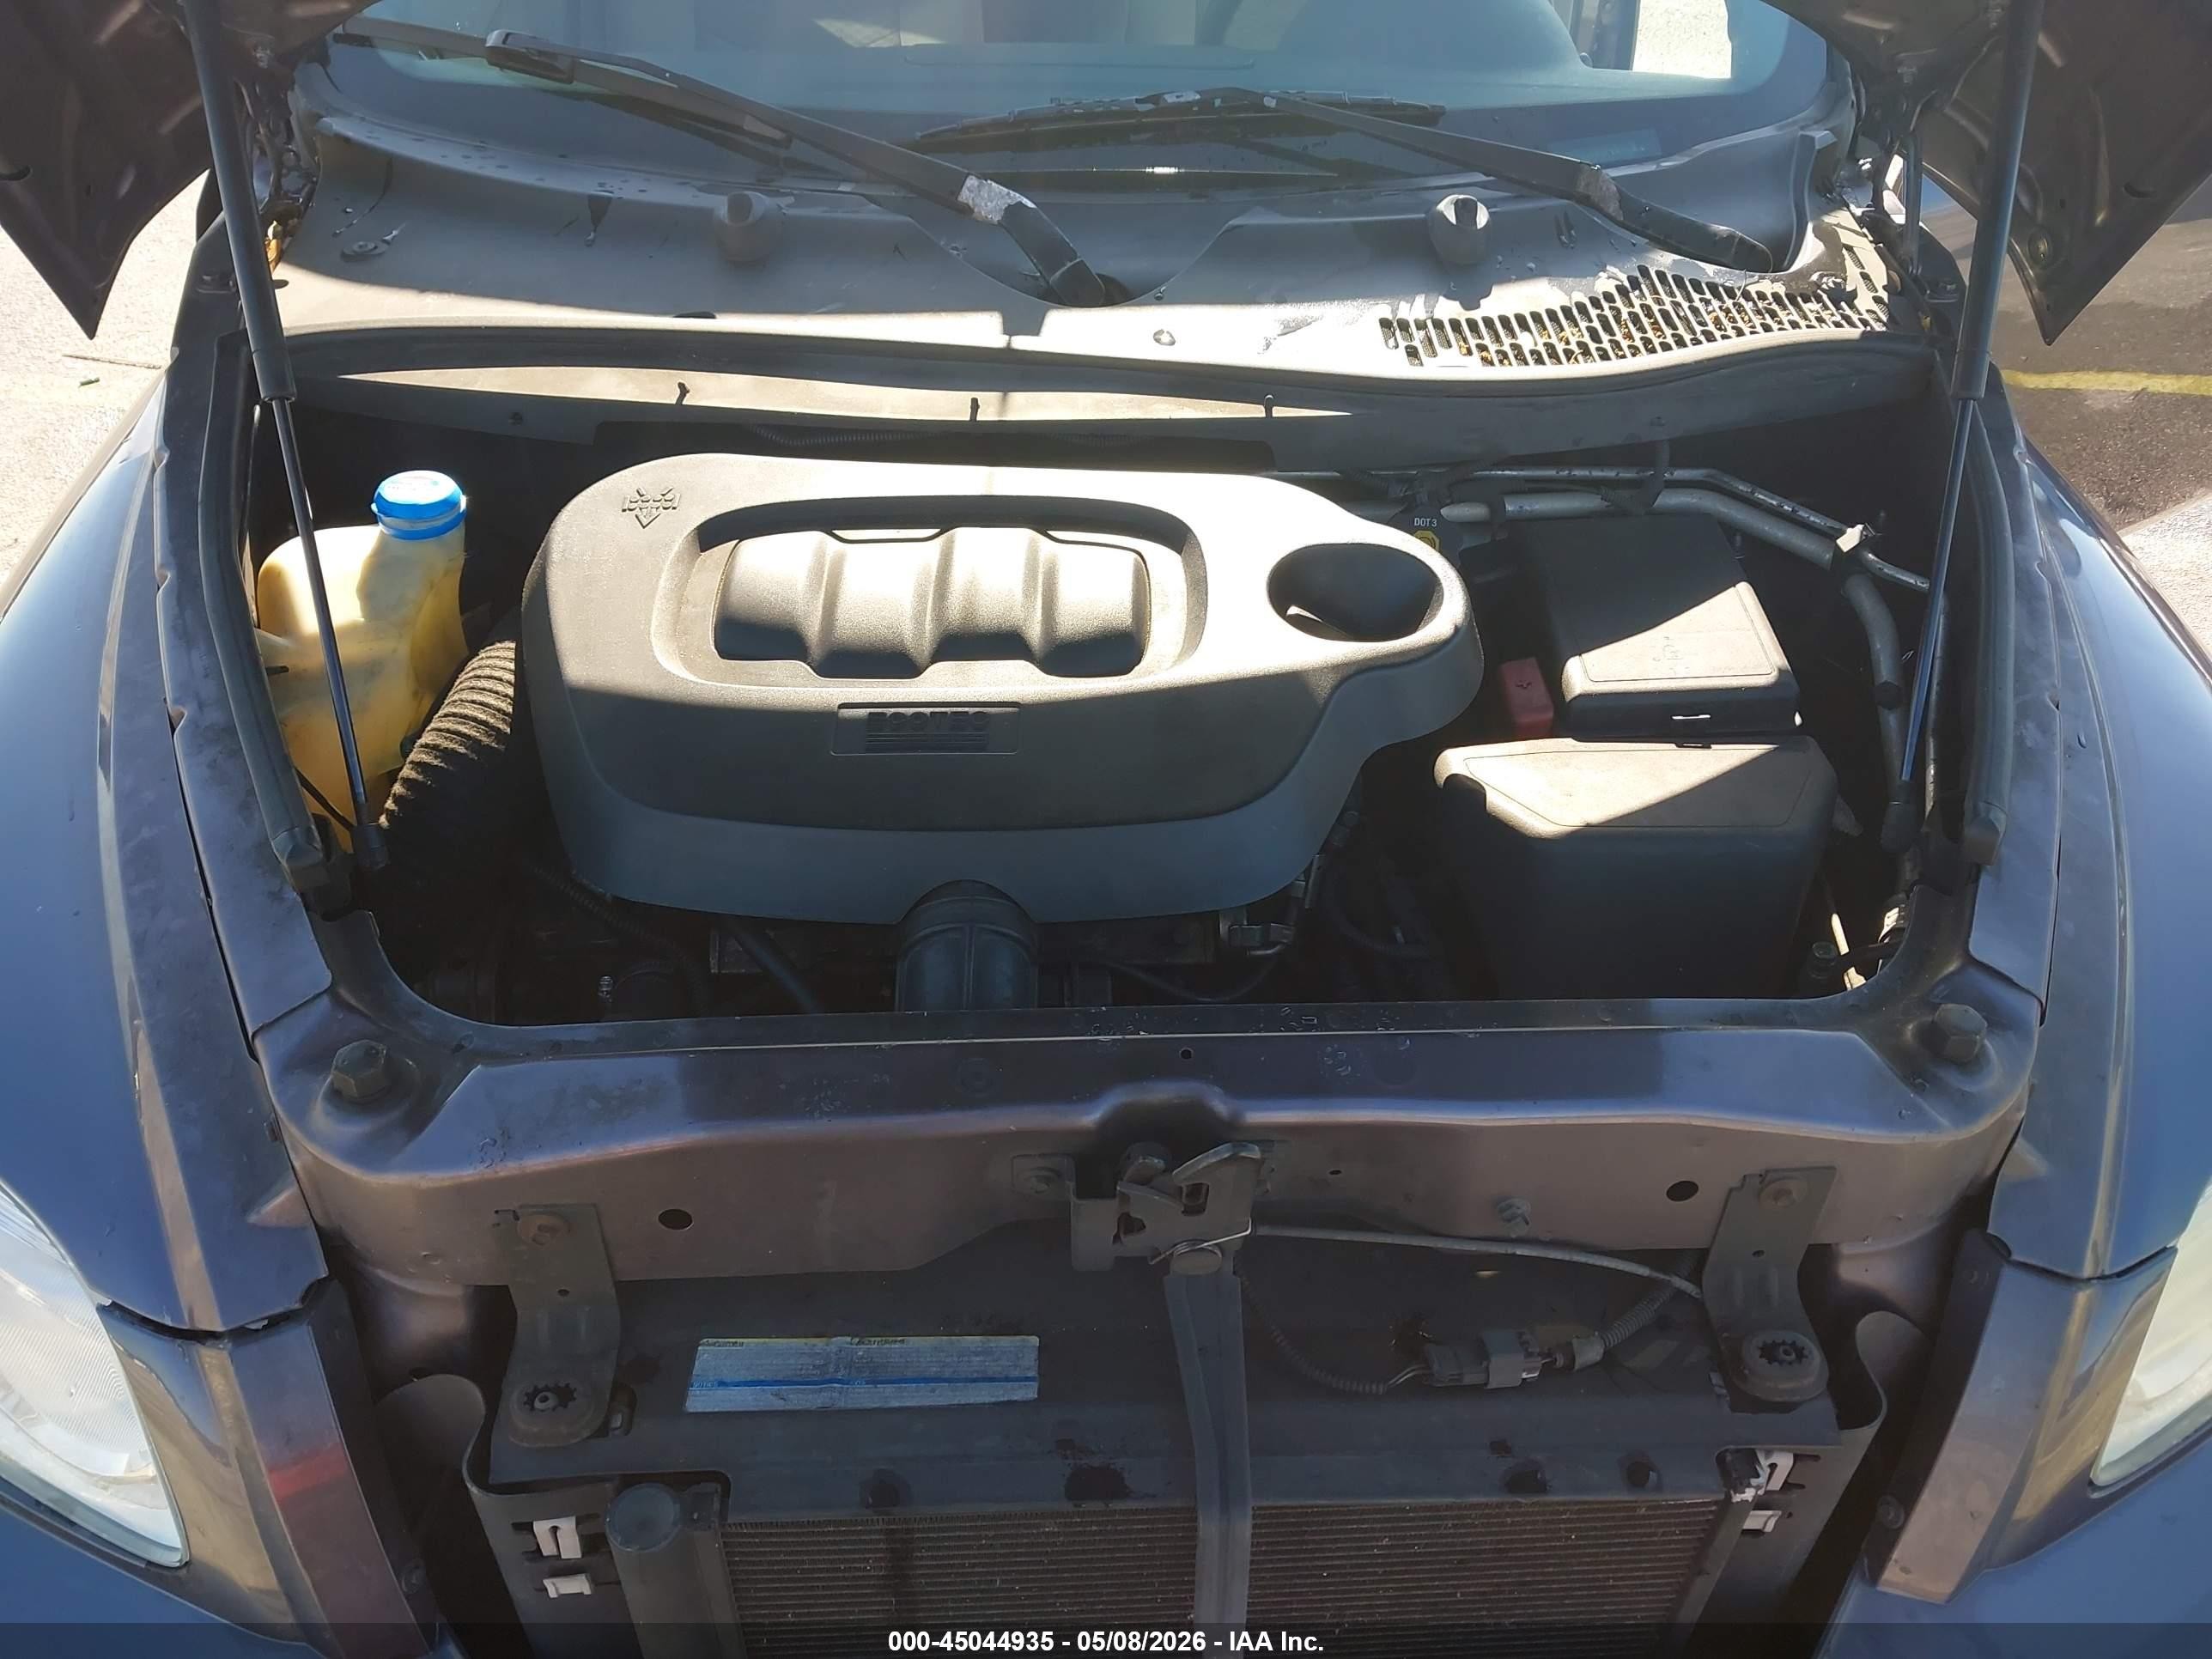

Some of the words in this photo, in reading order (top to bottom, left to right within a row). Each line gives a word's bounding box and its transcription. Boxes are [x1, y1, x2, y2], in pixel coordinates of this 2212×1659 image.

[1413, 517, 1431, 527] DOT
[1431, 518, 1437, 527] 3
[866, 711, 988, 731] ECOTEC
